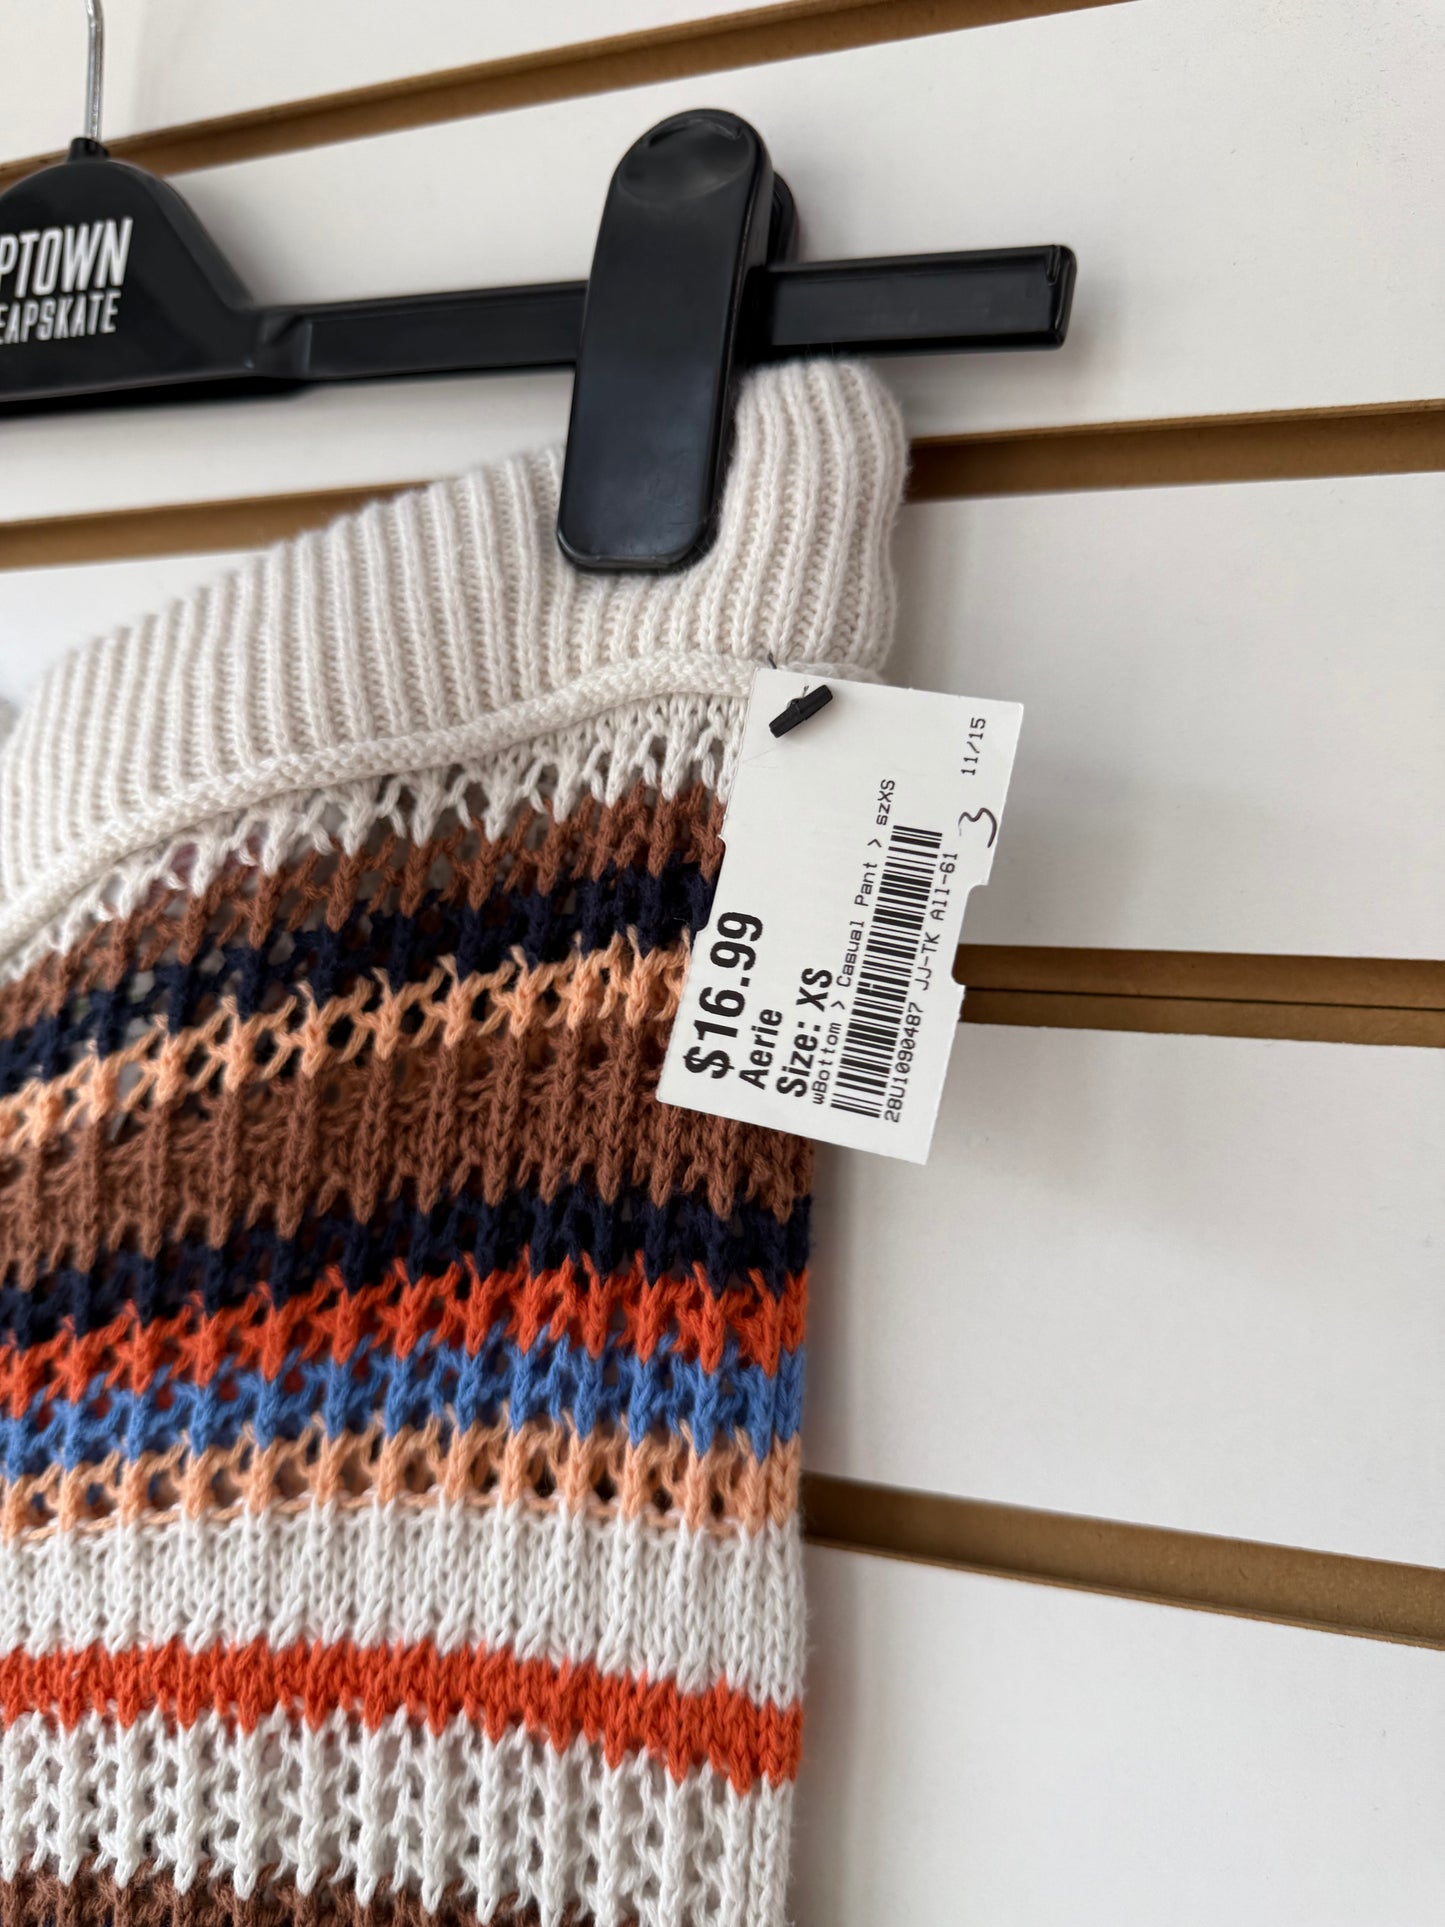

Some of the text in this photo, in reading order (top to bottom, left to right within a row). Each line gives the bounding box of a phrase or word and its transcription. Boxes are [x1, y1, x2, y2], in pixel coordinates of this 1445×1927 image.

[961, 717, 986, 776] 11/15
[958, 807, 998, 848] 3
[683, 911, 763, 1079] $16.99
[812, 1022, 842, 1105] wBottom
[836, 920, 865, 987] Casual
[854, 862, 878, 907] Pant
[876, 779, 895, 826] szXS
[738, 1008, 783, 1090] Aerie
[776, 967, 832, 1097] Size: XS
[884, 1002, 923, 1123] 28U1090487
[914, 931, 941, 991] JJ-TK
